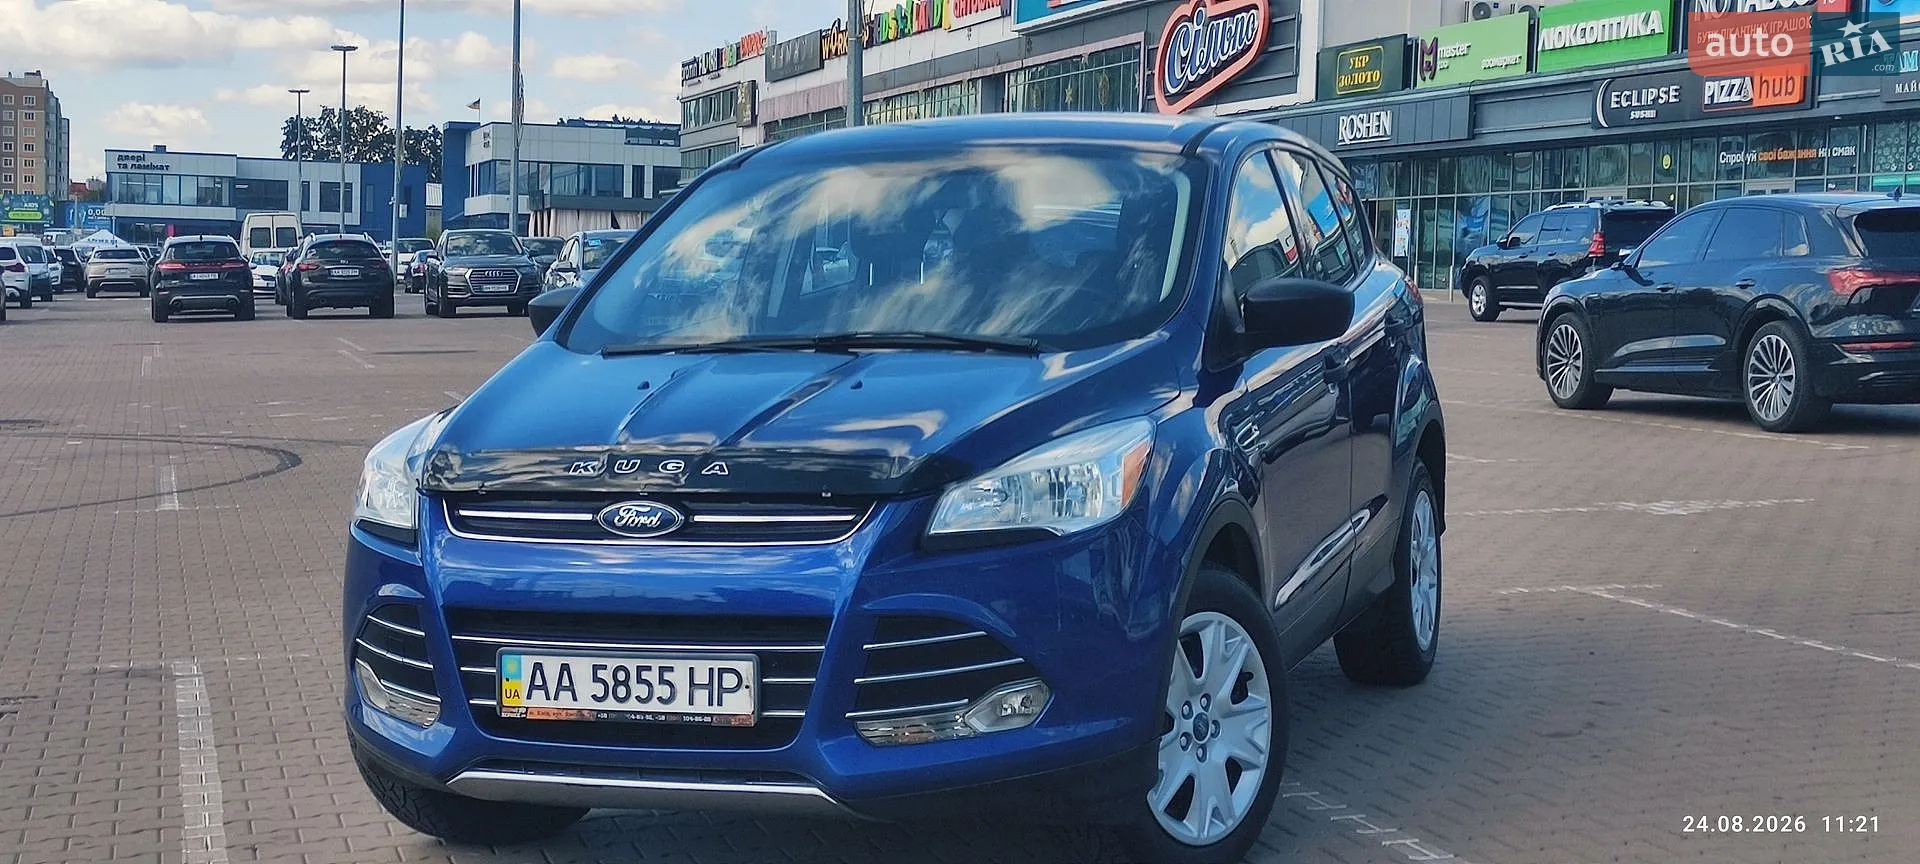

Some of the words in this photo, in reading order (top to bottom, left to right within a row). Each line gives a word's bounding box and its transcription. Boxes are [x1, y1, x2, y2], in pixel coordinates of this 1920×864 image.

[1165, 7, 1259, 94] Сільпо
[1438, 42, 1471, 58] master
[1350, 54, 1370, 70] УКР
[1338, 69, 1381, 88] ЗОЛОТО
[1704, 76, 1753, 105] PIZZA
[1759, 71, 1796, 99] hub
[1610, 85, 1681, 108] ECLIPSE
[1338, 110, 1392, 144] ROSHEN
[569, 459, 729, 476] KUGA
[613, 505, 663, 528] Ford
[504, 689, 521, 700] UA
[526, 662, 578, 702] AA
[591, 664, 676, 705] 5855
[688, 666, 743, 707] HP
